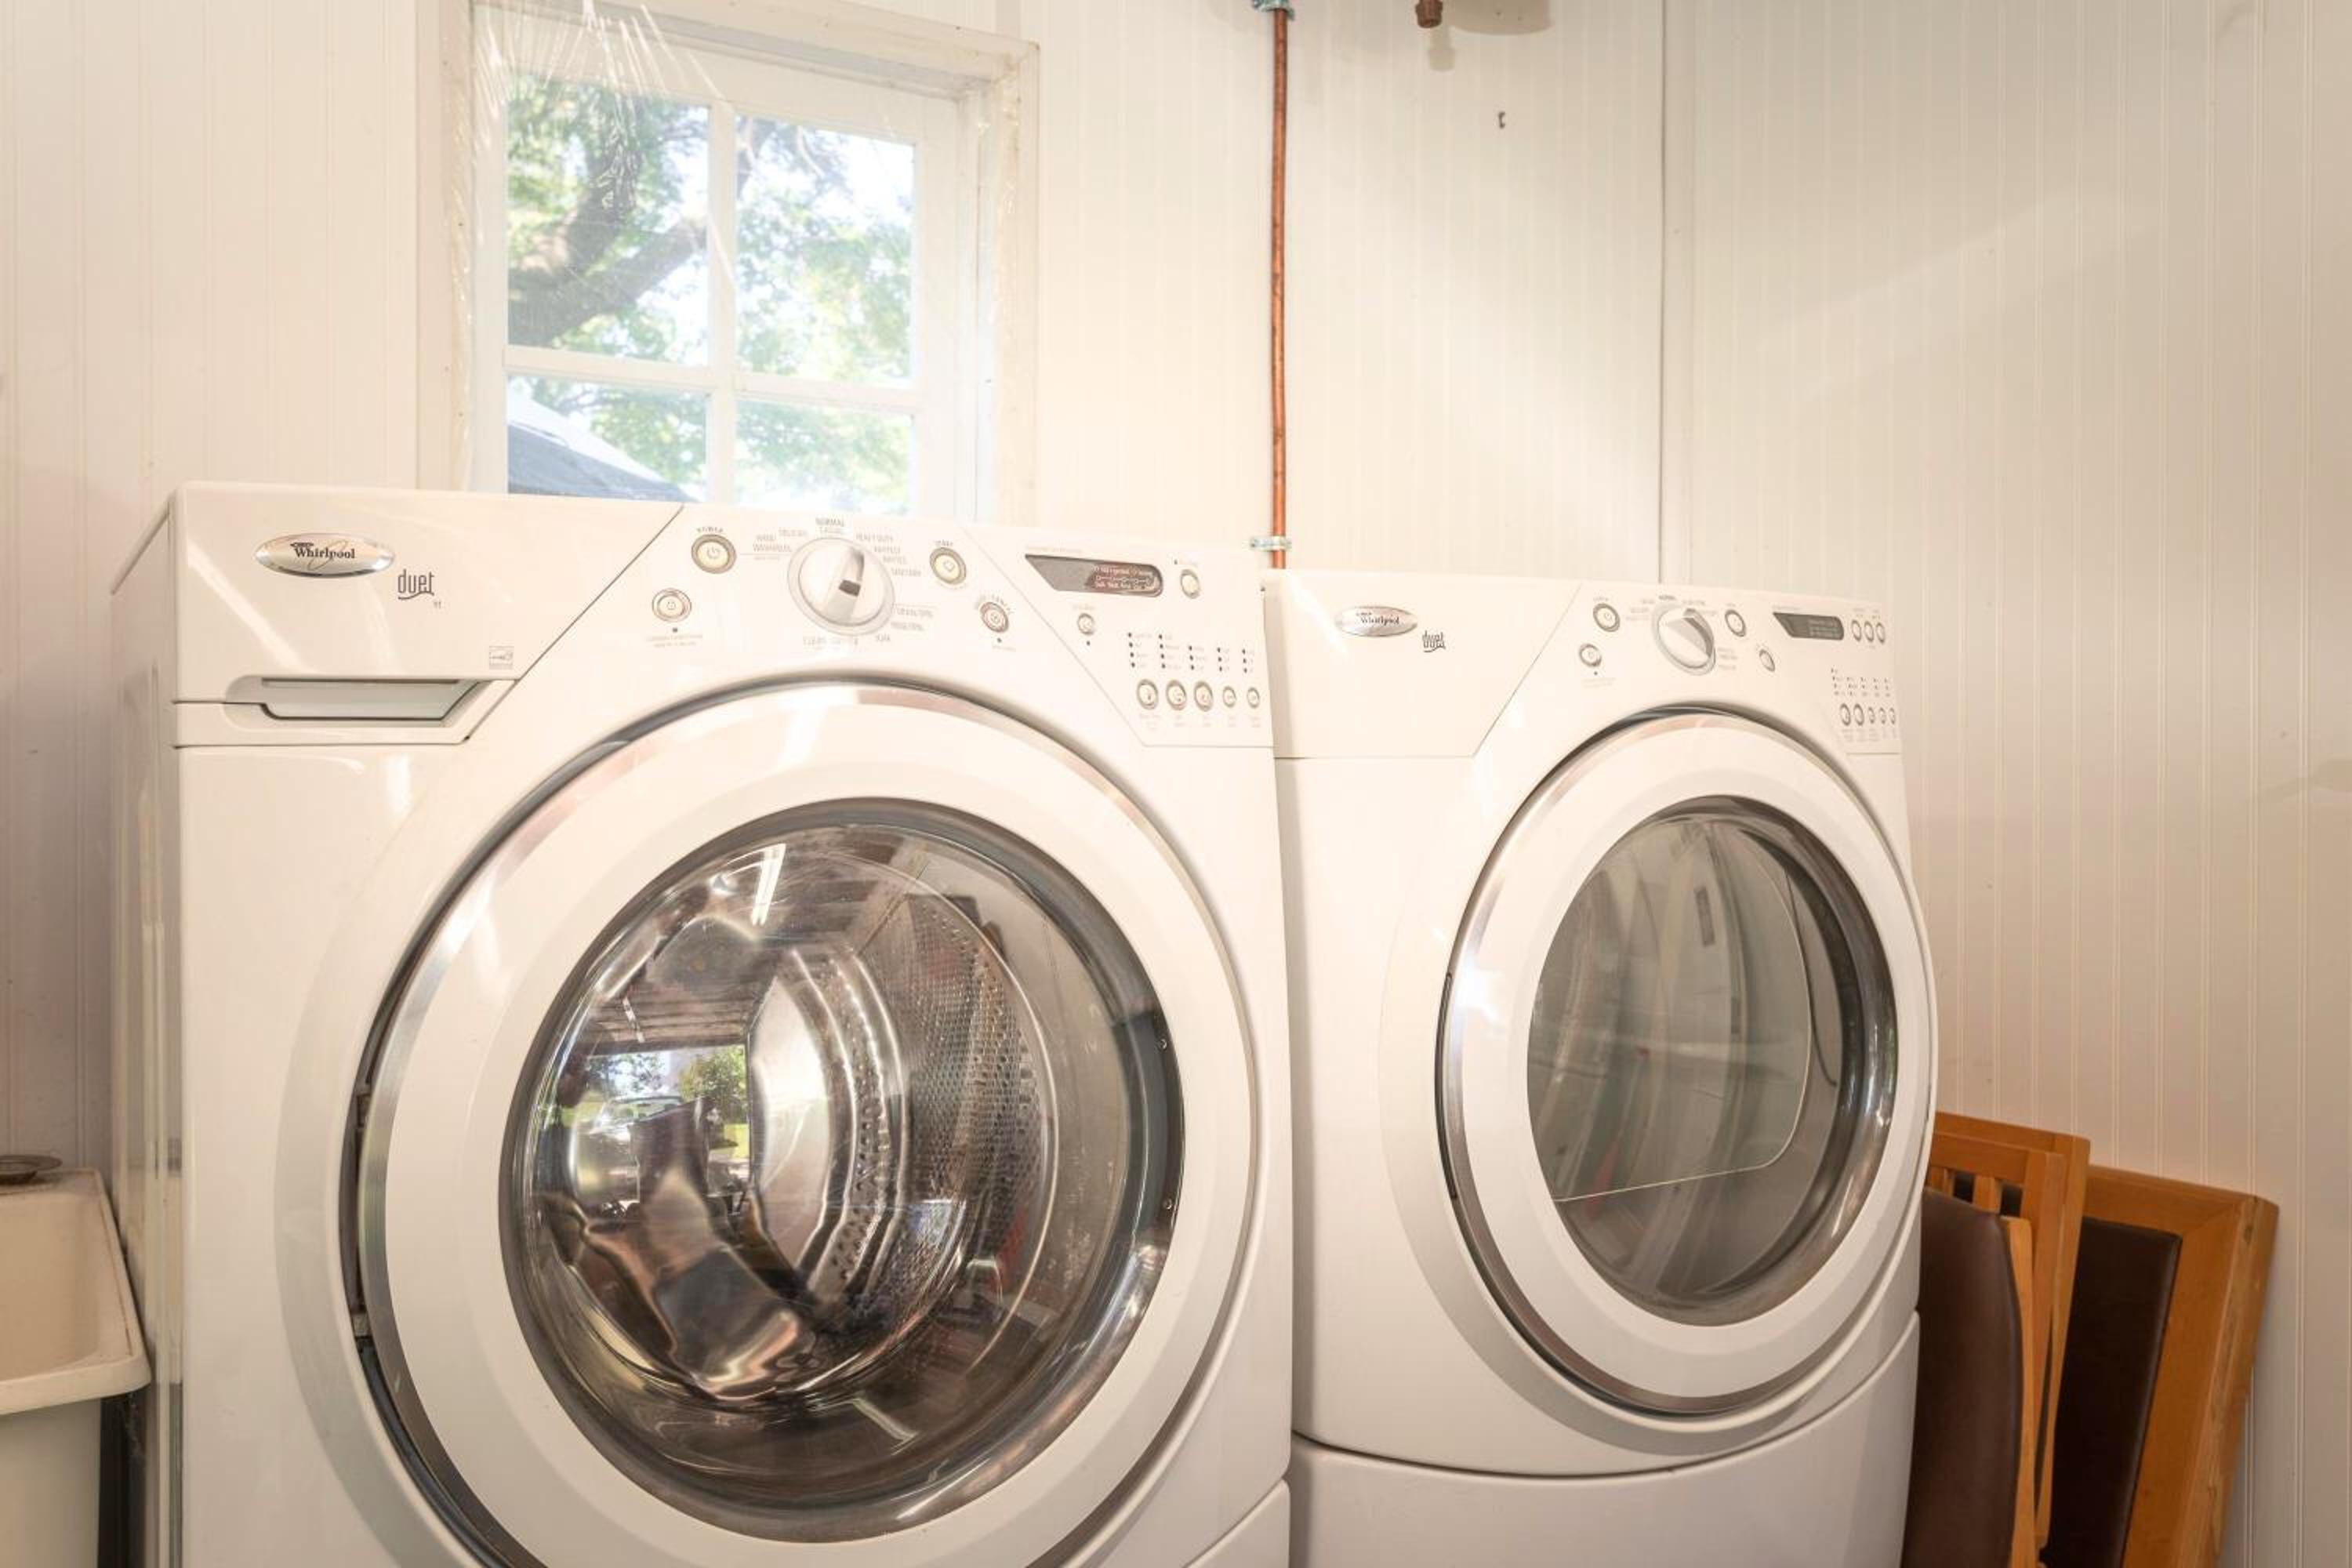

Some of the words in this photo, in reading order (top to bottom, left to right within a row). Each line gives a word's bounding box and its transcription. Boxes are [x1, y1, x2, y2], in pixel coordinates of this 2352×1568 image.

[294, 546, 355, 560] Whirlpool
[397, 569, 435, 600] duet
[1360, 615, 1399, 626] Whirlpool
